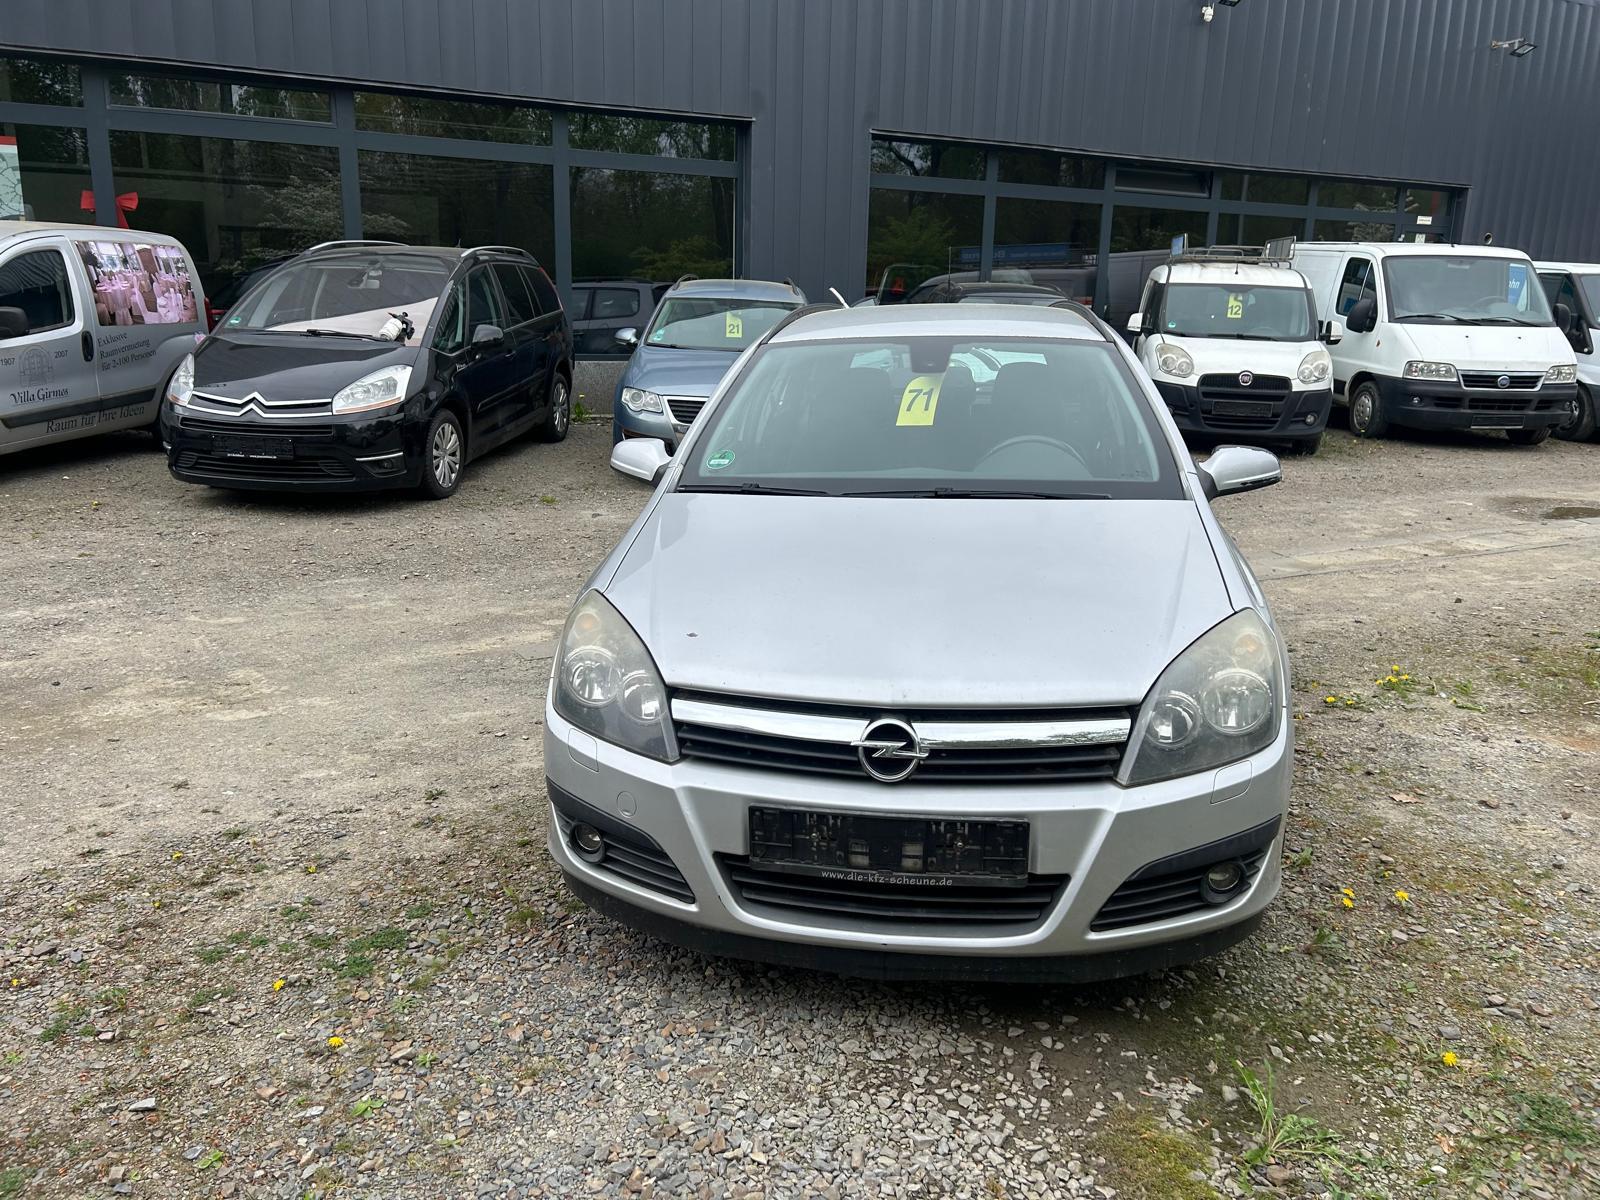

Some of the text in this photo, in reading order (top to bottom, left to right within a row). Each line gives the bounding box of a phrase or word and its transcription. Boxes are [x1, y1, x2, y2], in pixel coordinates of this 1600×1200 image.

[1229, 304, 1241, 316] 12
[728, 323, 740, 334] 21
[9, 387, 69, 404] Villa Girmes
[905, 387, 934, 412] 71
[46, 418, 78, 434] Raum
[119, 405, 145, 419] Ideen
[821, 870, 953, 887] www.die-kfz-scheune.de
